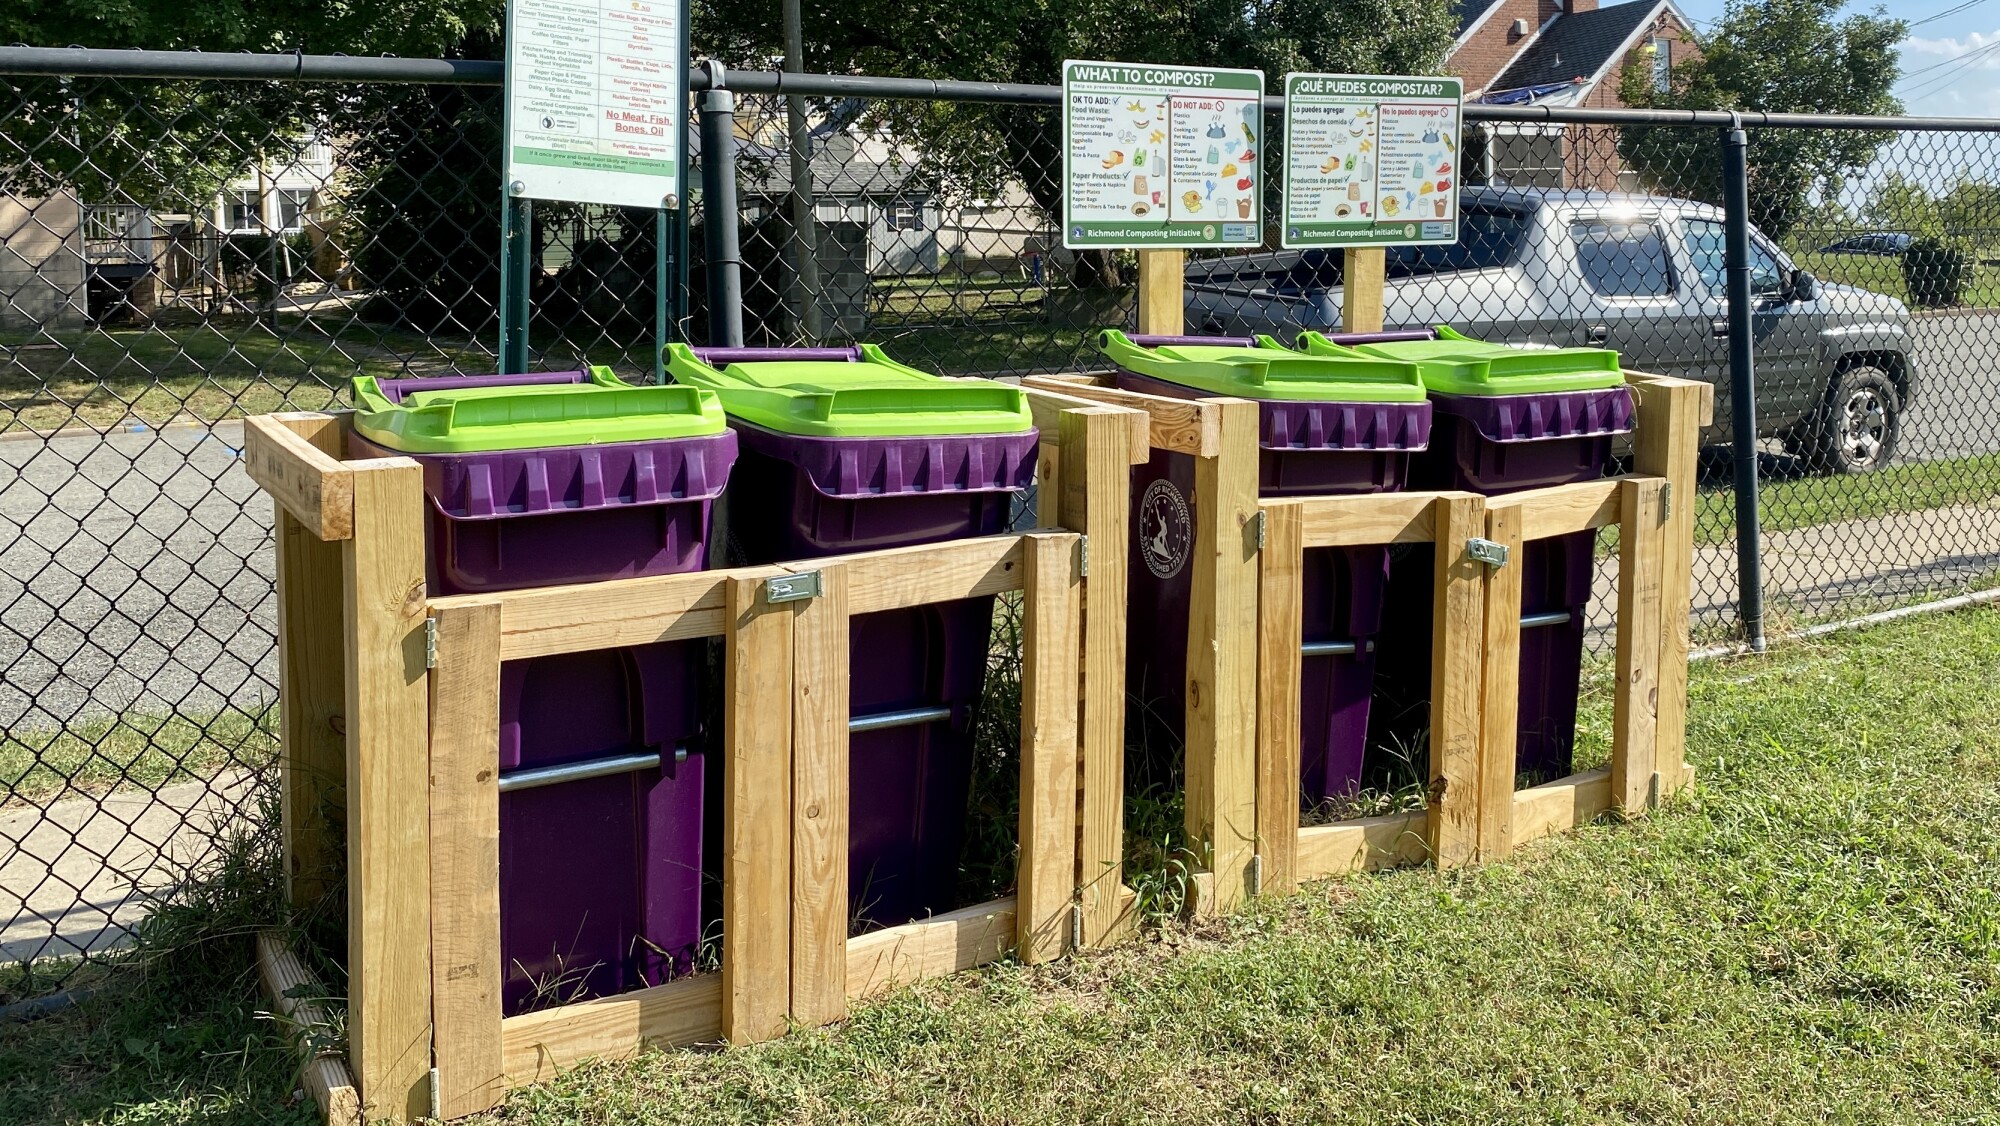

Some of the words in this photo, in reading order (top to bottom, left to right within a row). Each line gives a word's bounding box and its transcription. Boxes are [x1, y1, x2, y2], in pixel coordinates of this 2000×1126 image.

[1074, 66, 1119, 81] WHAT
[1122, 69, 1141, 82] TO
[1144, 71, 1215, 86] COMPOST?
[1295, 77, 1324, 95] ¿QUÉ
[1326, 81, 1367, 94] PUEDES
[1369, 82, 1443, 95] COMPOSTAR?
[1072, 96, 1082, 104] OK
[1084, 96, 1093, 104] TO
[1095, 97, 1111, 105] ADD:
[1173, 101, 1182, 109] DO
[606, 110, 620, 119] No
[1301, 106, 1322, 114] puedes
[1323, 107, 1345, 115] agregar
[651, 126, 664, 135] Oil
[1072, 172, 1091, 180] Paper
[1328, 177, 1343, 185] papel
[1088, 229, 1125, 237] Richmond
[1126, 229, 1168, 239] Composting
[1169, 228, 1201, 237] Initiative
[1303, 230, 1335, 238] Richmond
[1336, 229, 1374, 238] Composting
[1374, 228, 1403, 236] Initiative
[1145, 491, 1155, 508] CITY
[1154, 486, 1162, 495] OF
[1162, 485, 1186, 524] RICHMOND
[1143, 536, 1170, 573] ESTABLISHED
